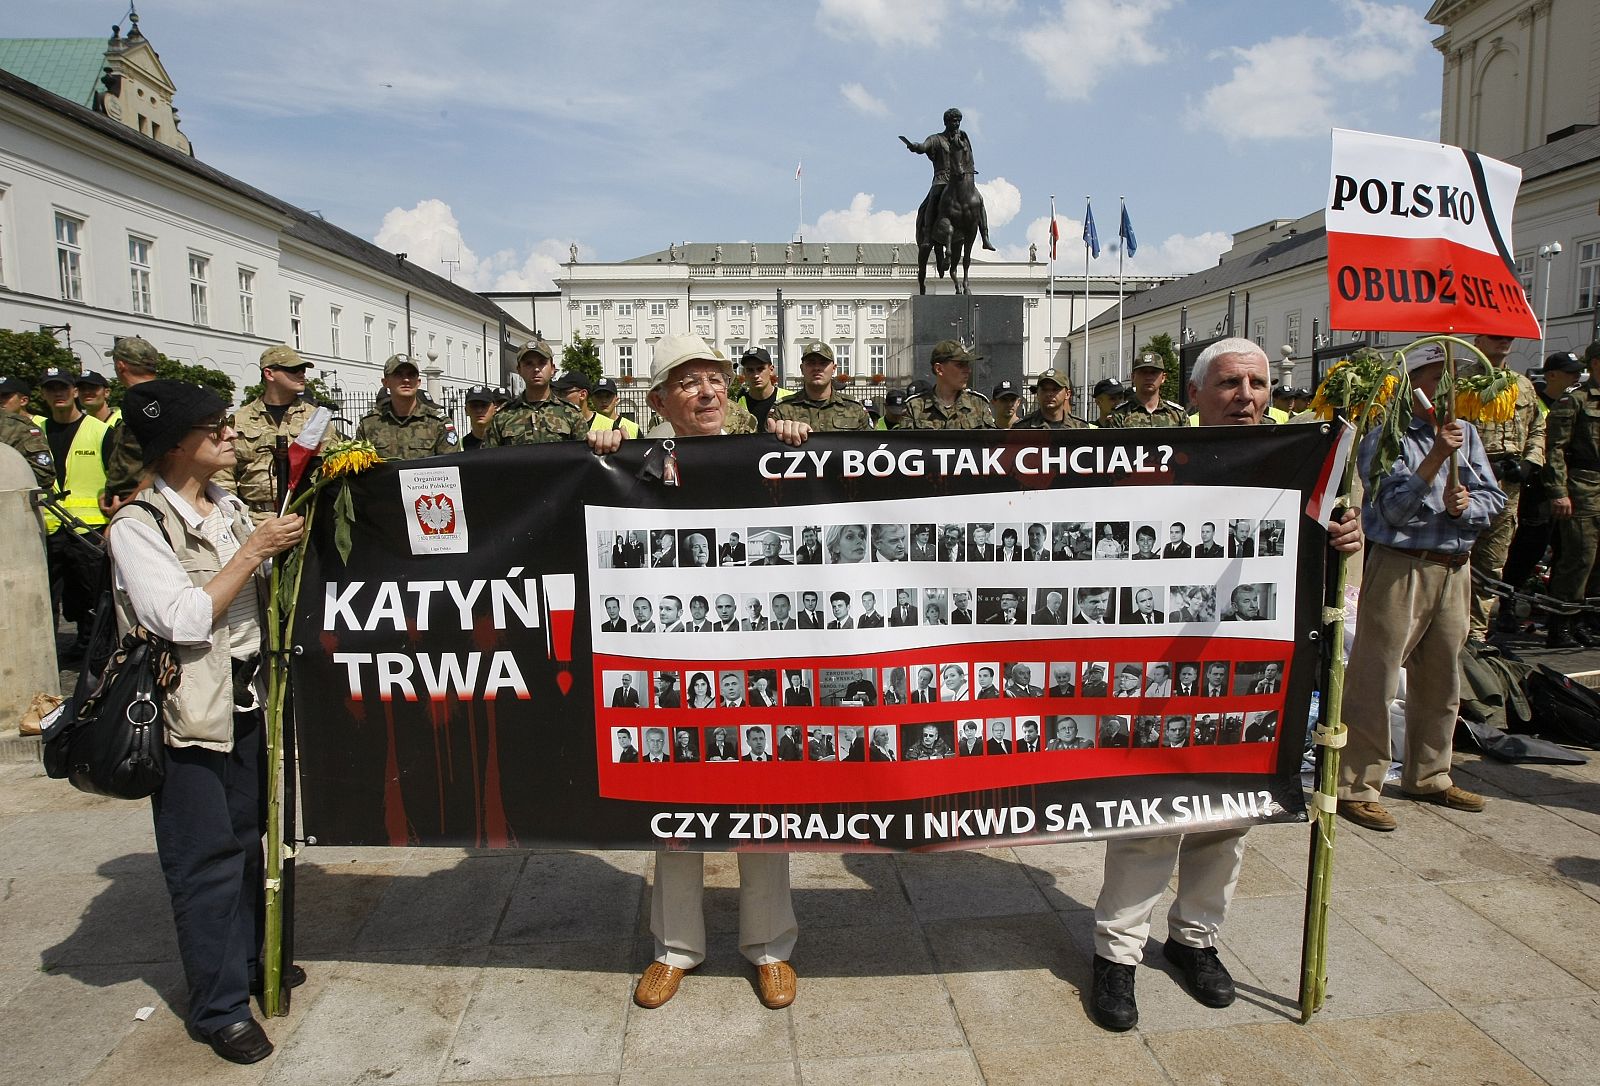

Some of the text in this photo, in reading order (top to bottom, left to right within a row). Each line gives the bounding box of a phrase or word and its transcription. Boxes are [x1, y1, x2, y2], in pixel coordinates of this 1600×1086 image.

[1331, 174, 1475, 225] POLSKO
[1337, 264, 1456, 305] OBUDŹ
[758, 443, 1174, 479] CZY BÓG TAK CHCIAŁ?
[323, 566, 540, 631] KATYŃ
[333, 650, 532, 702] TRWA
[650, 790, 1273, 840] CZY ZDRAJCY I NKWD SĄ TAK SILNI?
